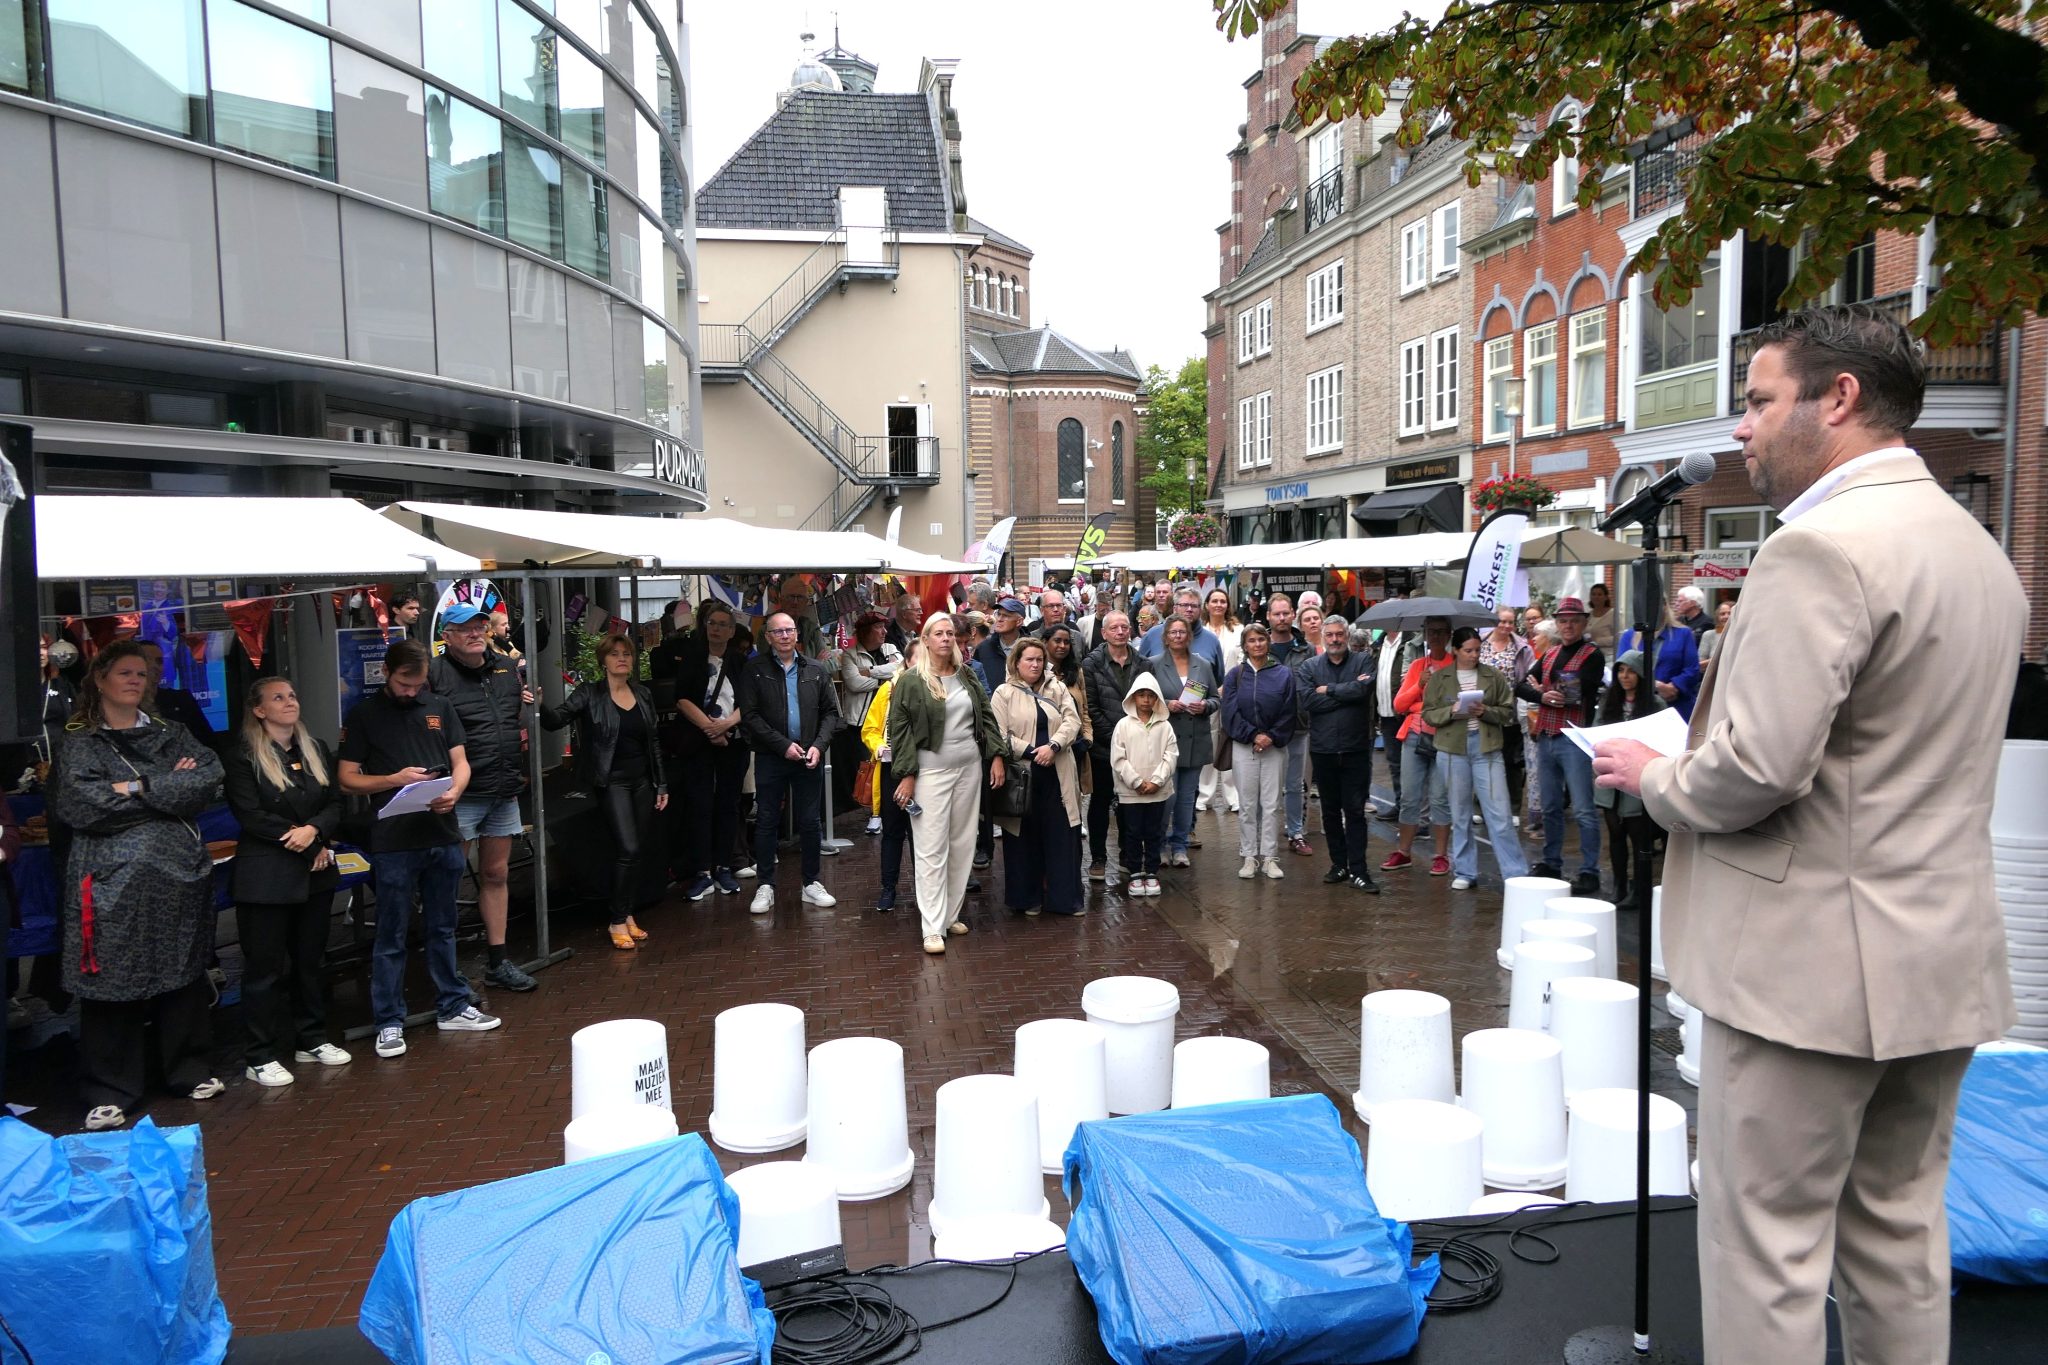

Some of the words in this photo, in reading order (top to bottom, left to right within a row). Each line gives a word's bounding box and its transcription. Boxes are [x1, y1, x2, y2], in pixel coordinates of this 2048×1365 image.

[1265, 482, 1308, 501] TONYSON
[1485, 540, 1505, 611] ORKEST
[639, 1056, 664, 1077] MAAK
[635, 1069, 667, 1092] MUZIEK
[646, 1086, 662, 1104] MEE
